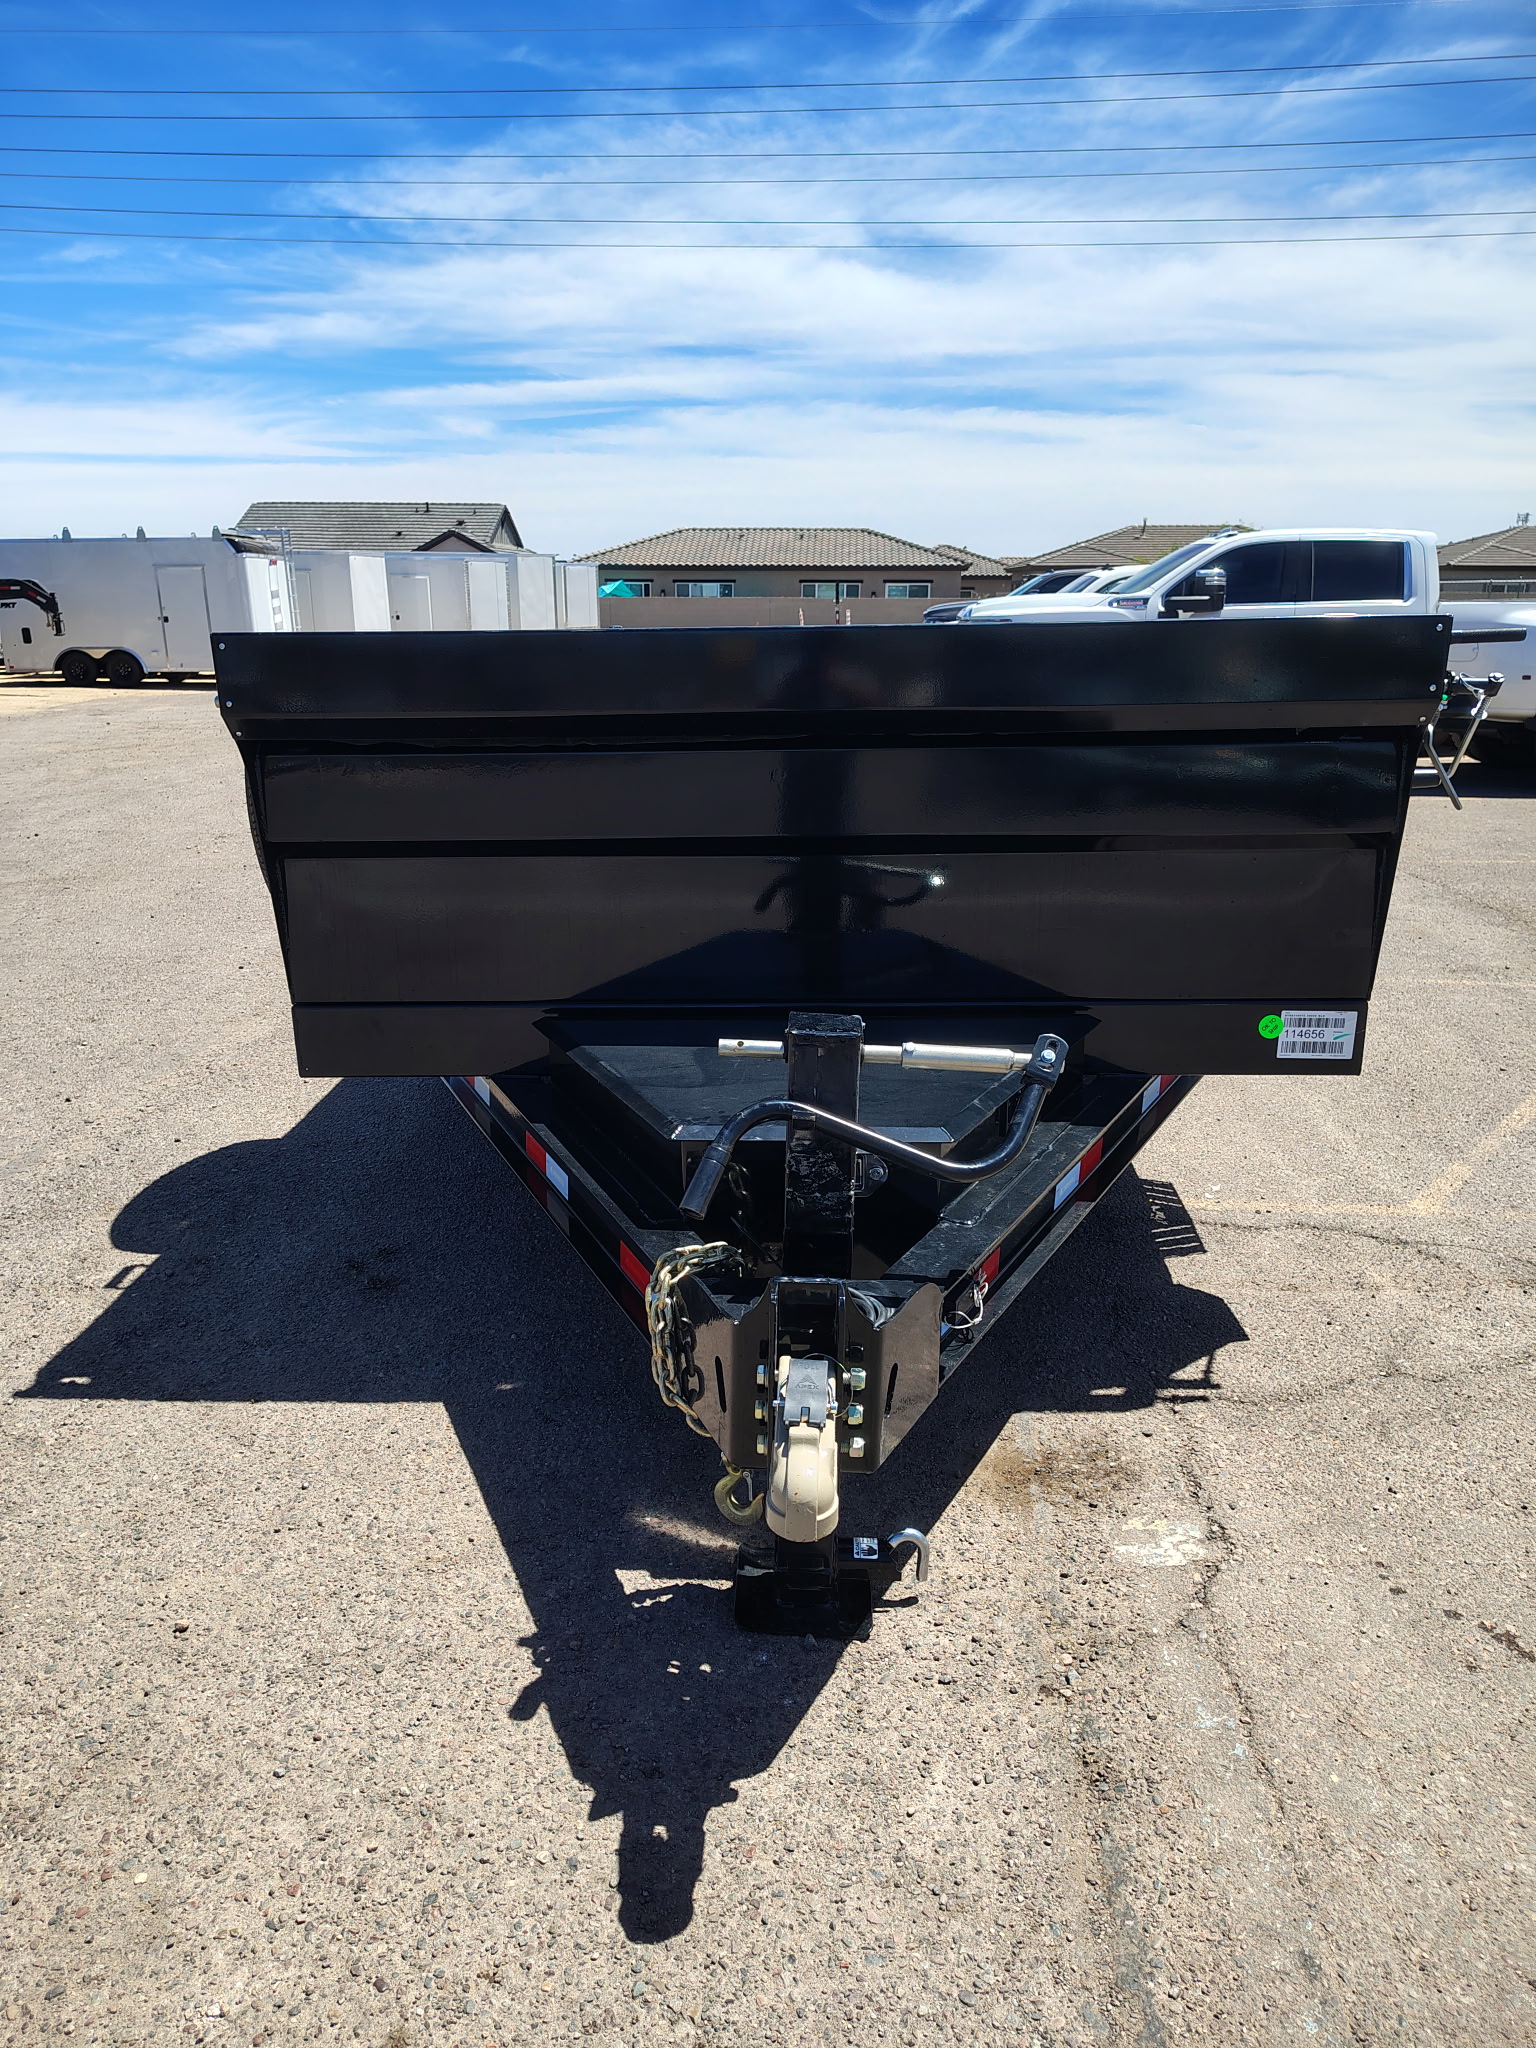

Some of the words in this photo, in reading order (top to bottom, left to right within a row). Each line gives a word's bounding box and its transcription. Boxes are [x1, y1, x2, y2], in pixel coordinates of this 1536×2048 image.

[1262, 1024, 1270, 1032] OK
[1269, 1017, 1277, 1025] TO
[1268, 1024, 1279, 1034] SHIP
[1285, 1030, 1325, 1039] 114656
